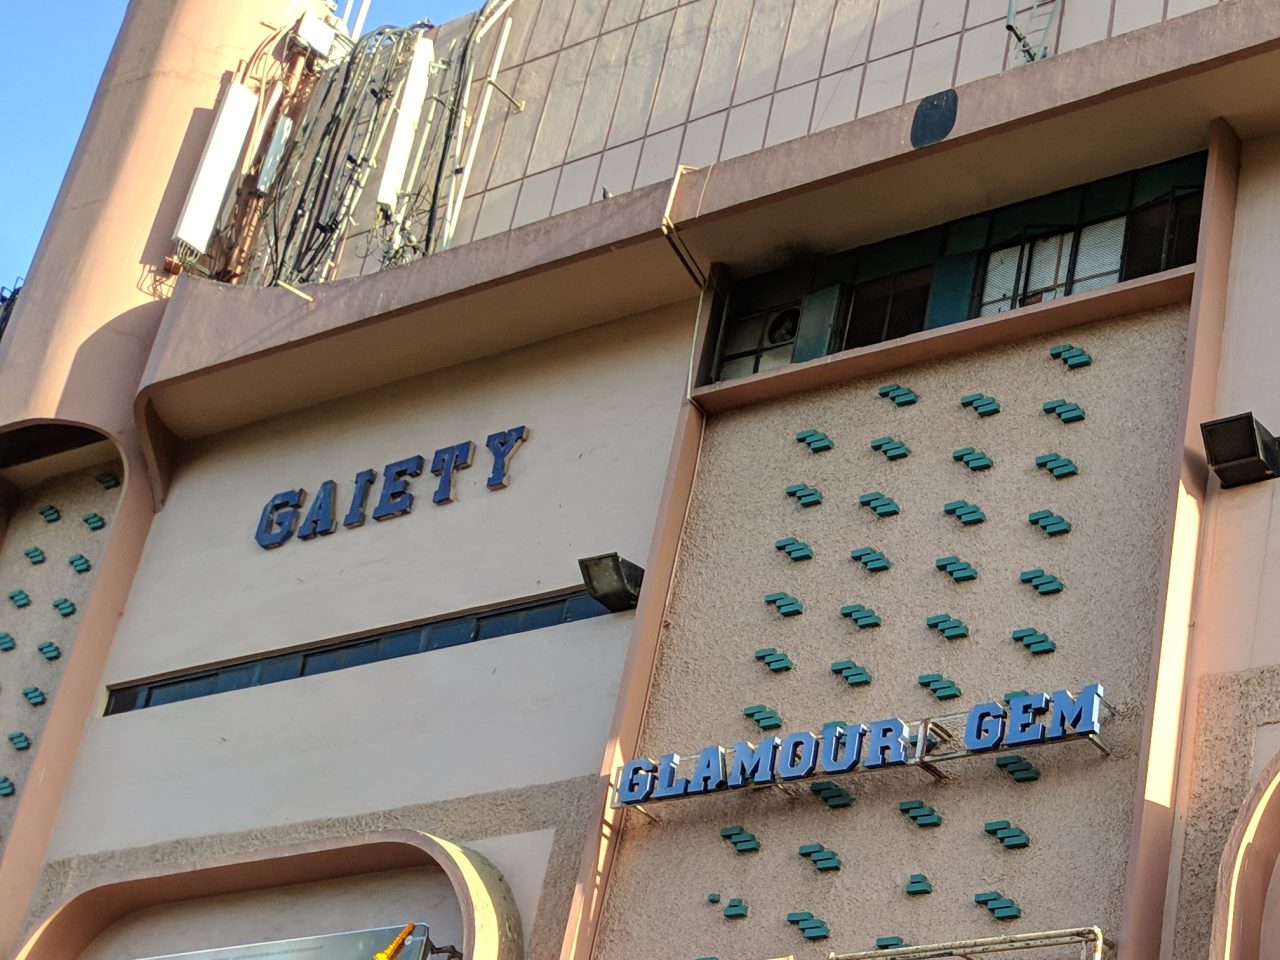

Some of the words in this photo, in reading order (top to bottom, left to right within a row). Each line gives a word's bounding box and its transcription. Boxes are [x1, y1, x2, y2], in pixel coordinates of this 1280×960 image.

[254, 425, 529, 550] GAIETY
[619, 717, 909, 804] GLAMOUR
[963, 683, 1104, 753] GEM
